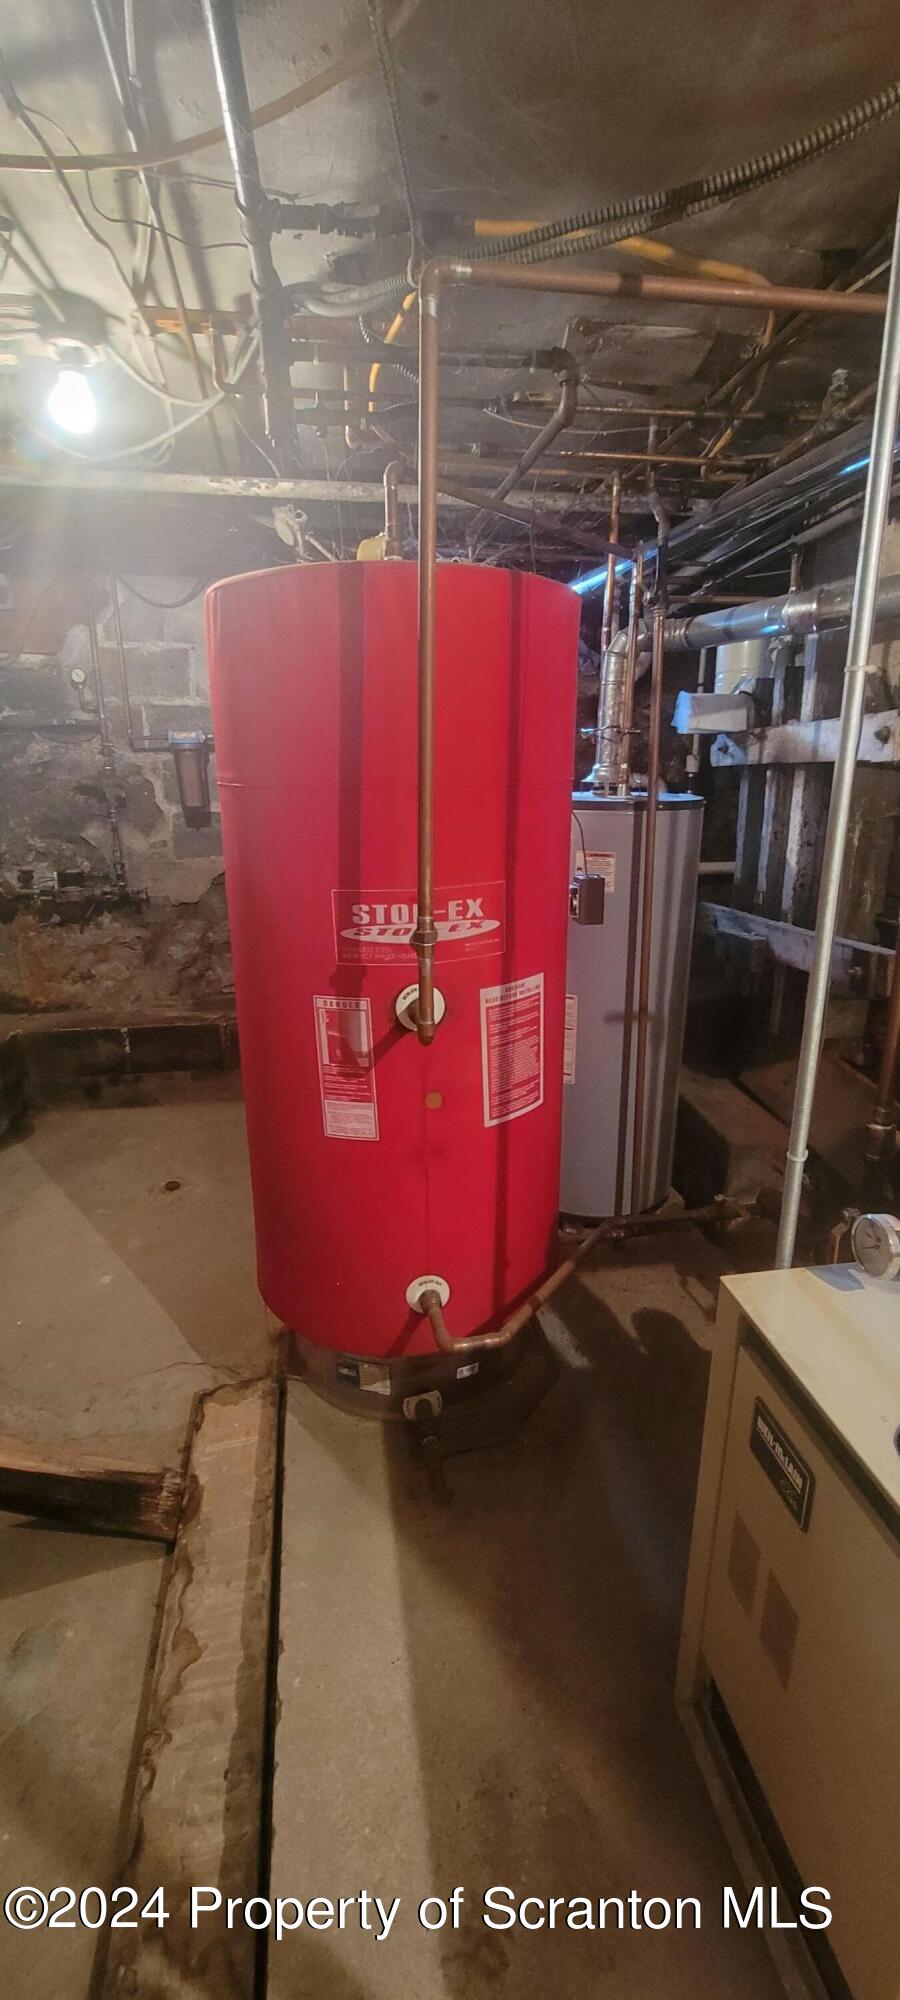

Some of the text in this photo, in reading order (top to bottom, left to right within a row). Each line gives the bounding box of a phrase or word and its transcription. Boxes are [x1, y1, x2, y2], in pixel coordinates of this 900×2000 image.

[352, 898, 484, 924] STO-EX
[353, 921, 484, 937] STOEX
[323, 1000, 361, 1009] DANGER
